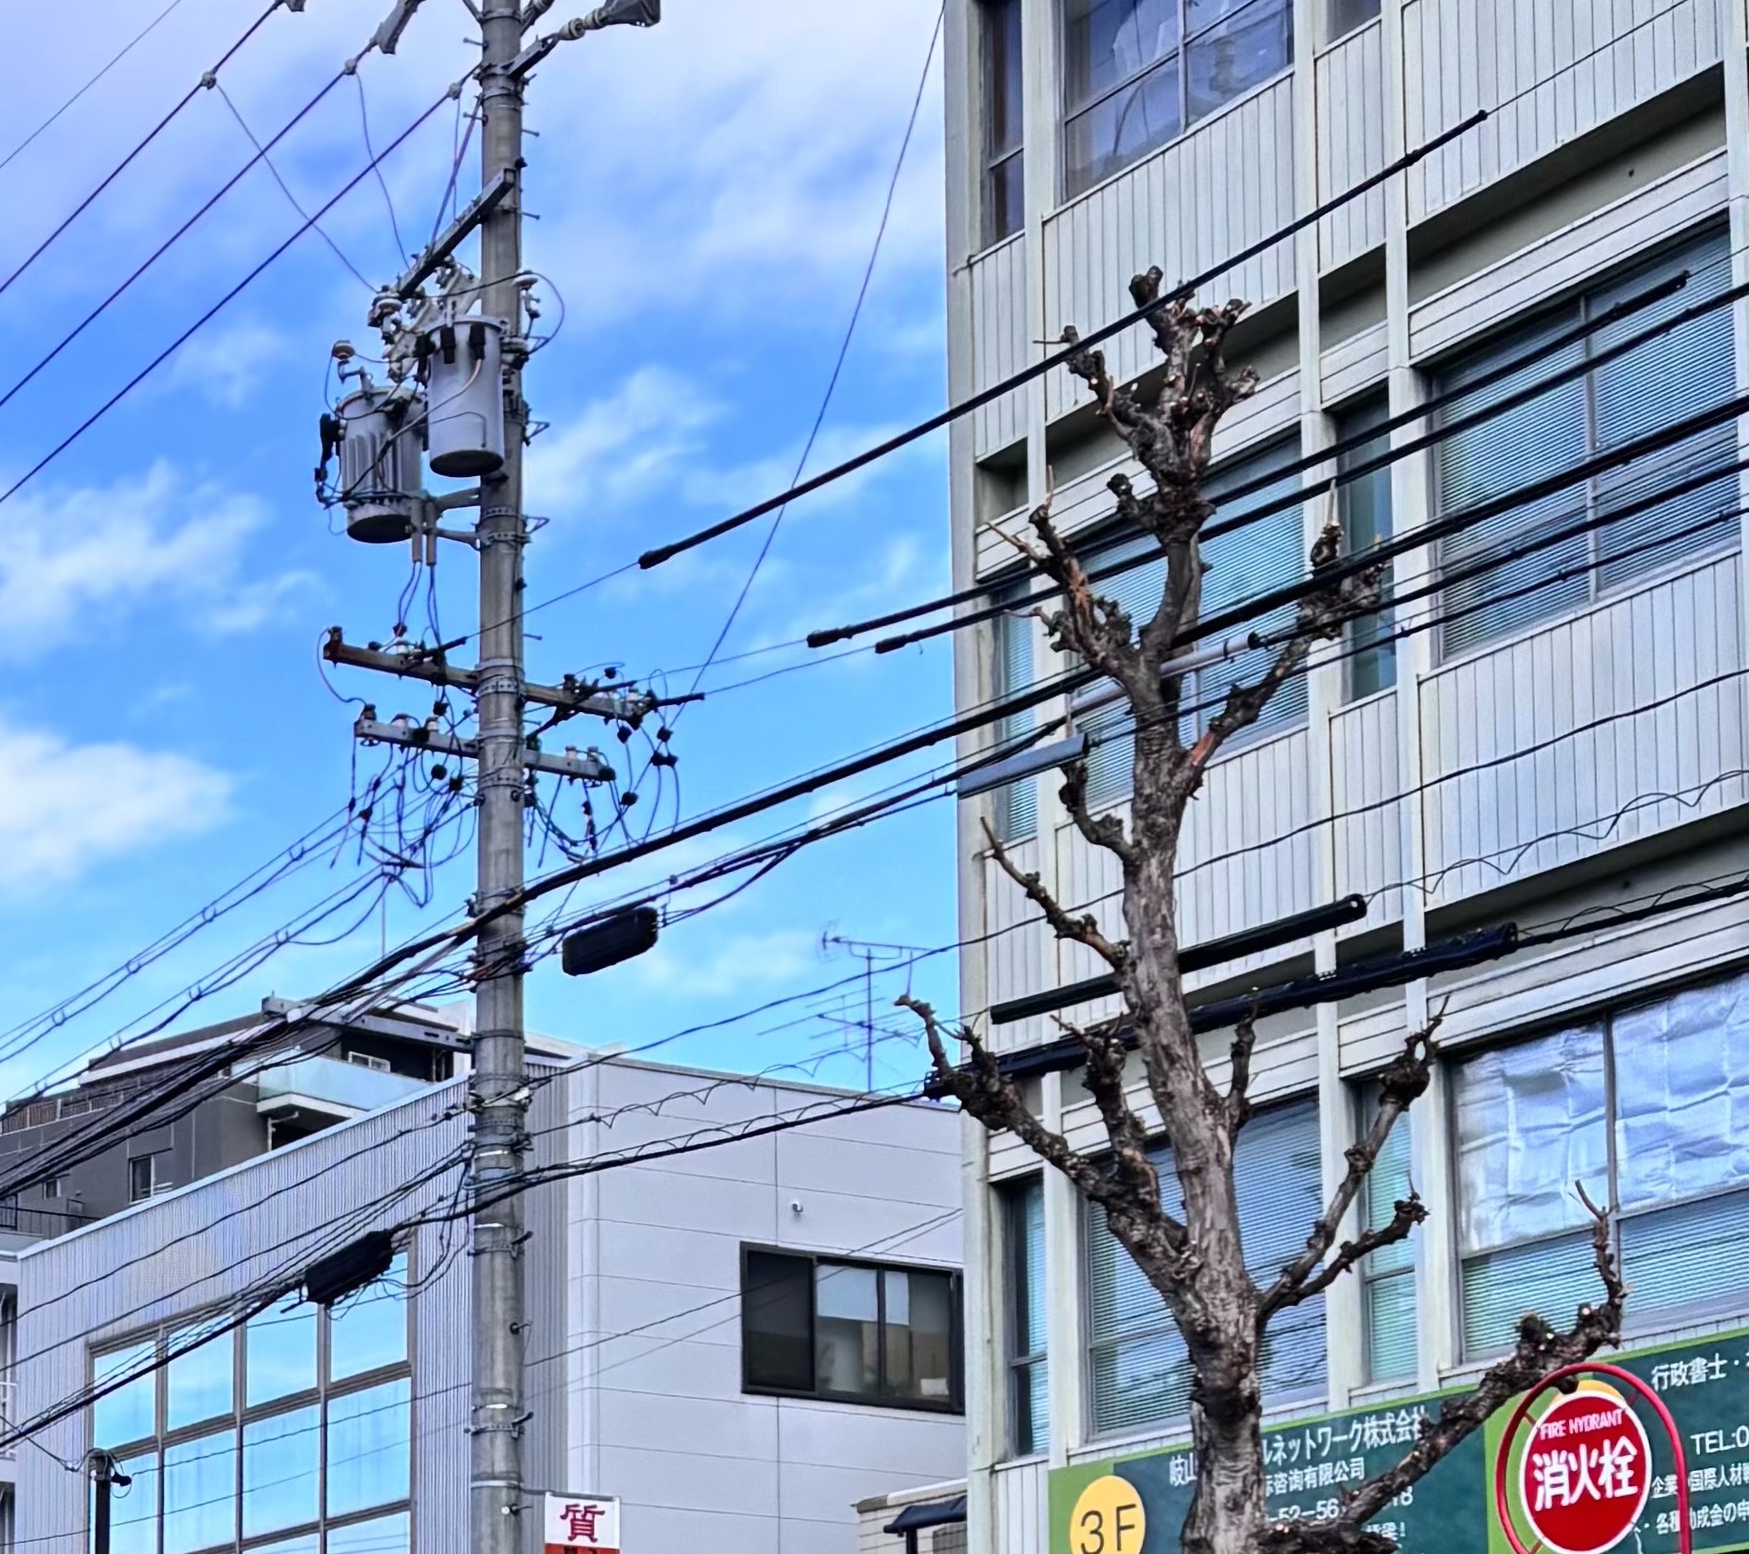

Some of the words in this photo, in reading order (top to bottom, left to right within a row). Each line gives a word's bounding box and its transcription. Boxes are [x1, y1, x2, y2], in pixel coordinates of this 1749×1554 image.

[1540, 1418, 1567, 1447] FIRE
[1568, 1408, 1623, 1441] HYDRANT
[1532, 1435, 1639, 1512] 消火栓
[559, 1503, 605, 1543] 質
